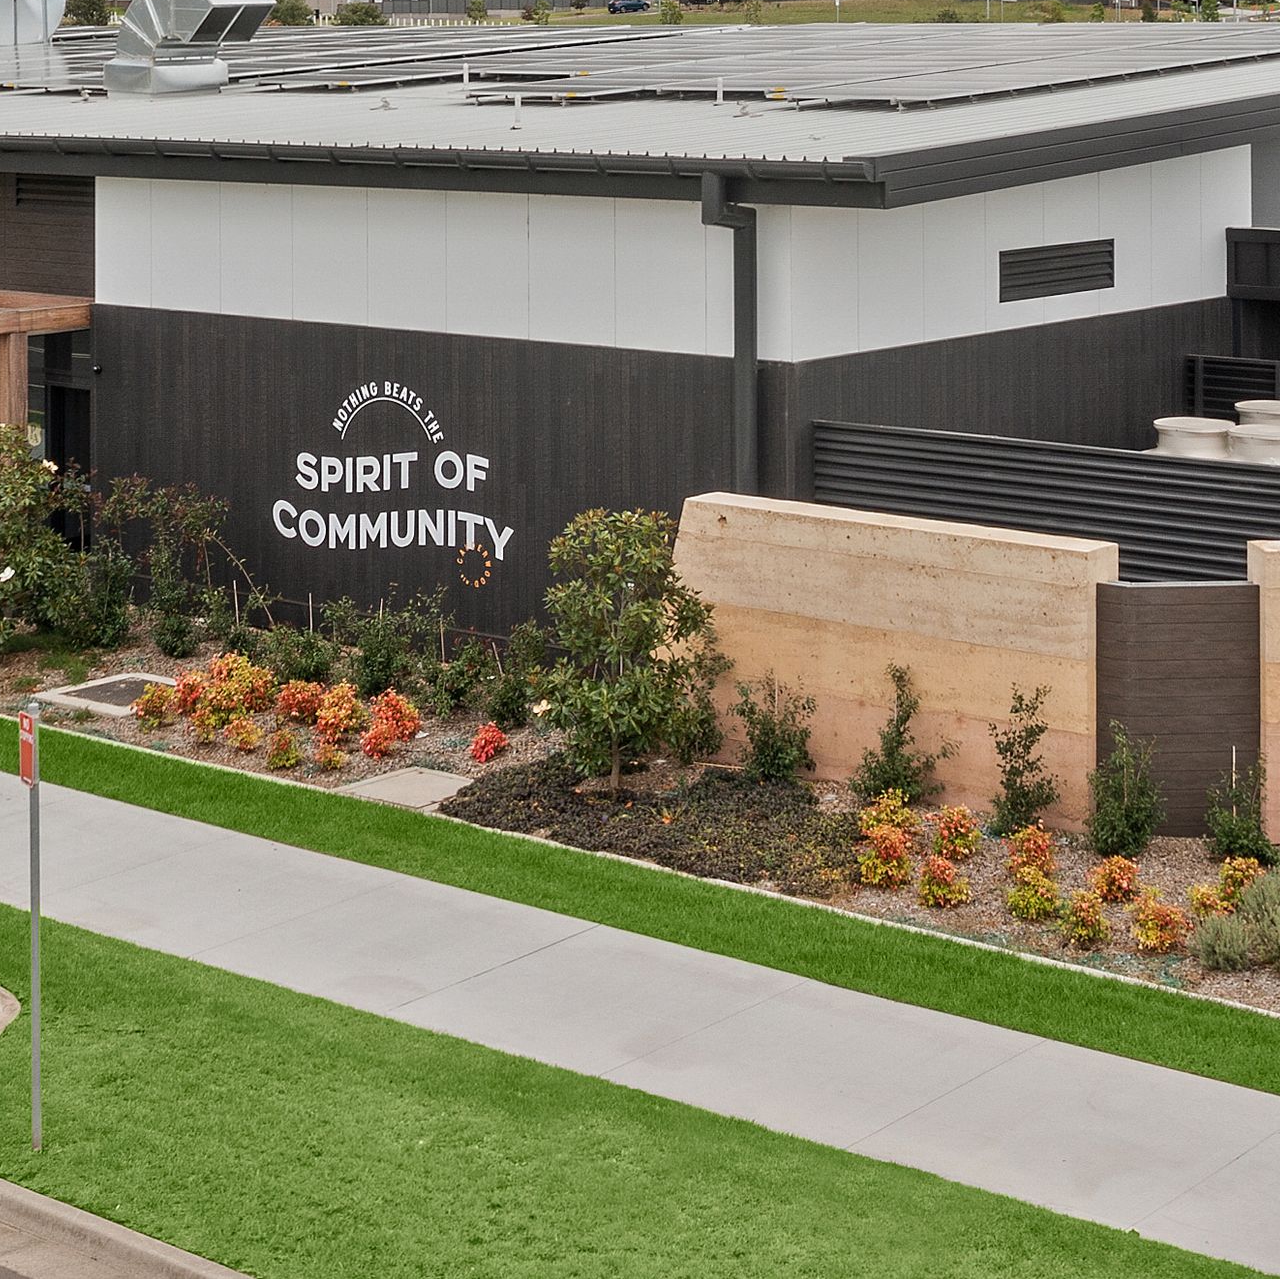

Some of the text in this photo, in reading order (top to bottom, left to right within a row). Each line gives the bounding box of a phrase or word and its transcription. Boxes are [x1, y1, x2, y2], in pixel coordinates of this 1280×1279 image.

[332, 381, 444, 444] NOTHING BEATS THE
[295, 450, 489, 493] SPIRIT OF
[272, 499, 514, 561] COMMUNITY
